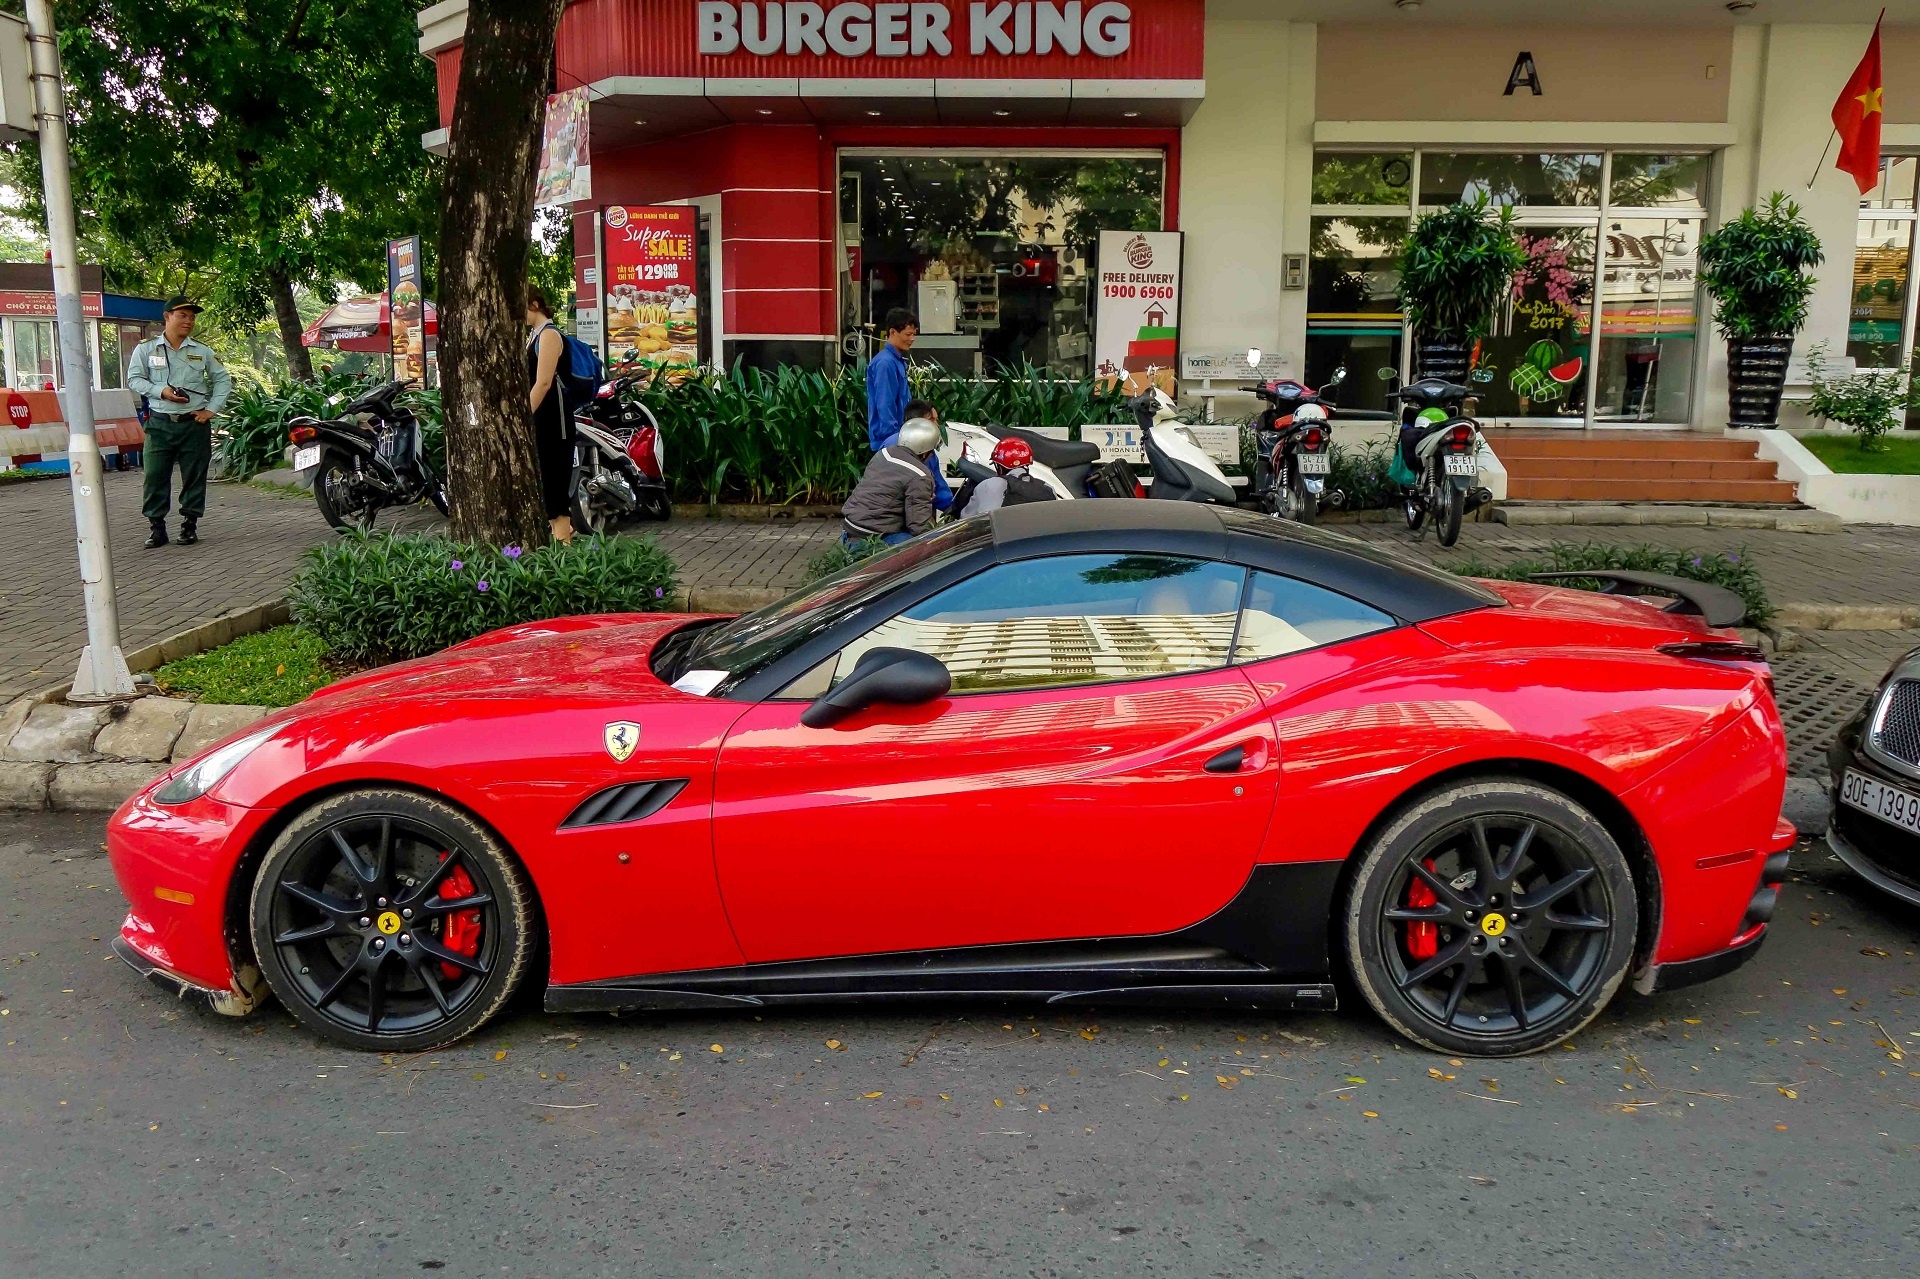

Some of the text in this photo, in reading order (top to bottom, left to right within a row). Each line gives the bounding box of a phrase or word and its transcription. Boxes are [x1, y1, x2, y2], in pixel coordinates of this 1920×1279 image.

[699, 1, 1131, 57] BURGER KING
[1502, 51, 1543, 96] A
[609, 213, 625, 223] KING
[623, 224, 671, 250] Super
[648, 239, 688, 257] SALE
[1129, 246, 1152, 257] BURGER
[1130, 251, 1153, 264] KING
[635, 264, 664, 280] 129
[1102, 272, 1175, 284] FREE DELIVERY
[1103, 285, 1174, 299] 1900 6960
[1529, 315, 1565, 330] 2017
[331, 331, 367, 340] WHOPPR
[10, 405, 29, 418] STOP
[1449, 456, 1472, 465] 36-E1
[72, 461, 82, 476] 2
[1303, 463, 1326, 472] 8738
[1447, 464, 1475, 474] 191.13
